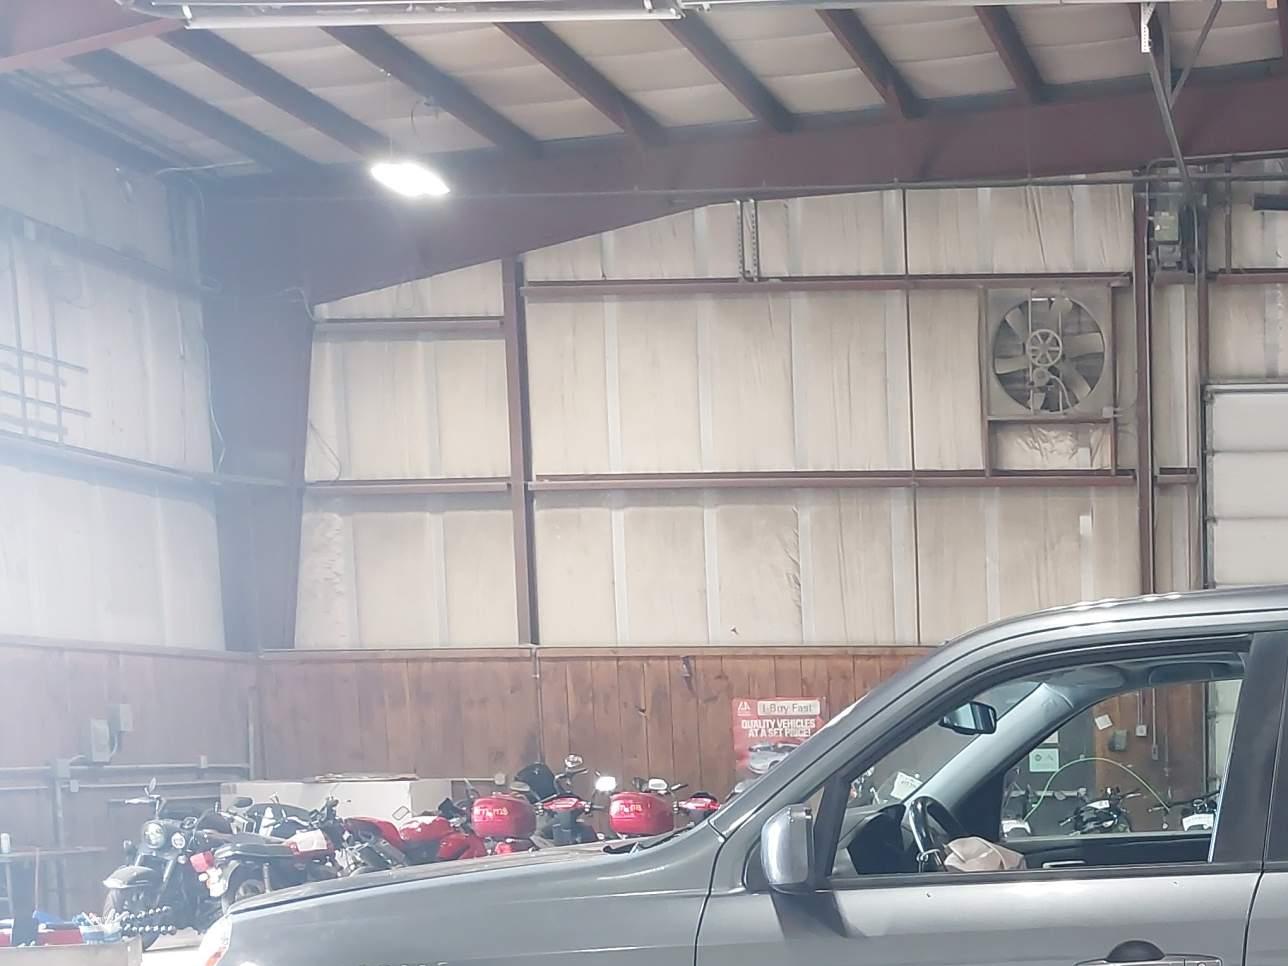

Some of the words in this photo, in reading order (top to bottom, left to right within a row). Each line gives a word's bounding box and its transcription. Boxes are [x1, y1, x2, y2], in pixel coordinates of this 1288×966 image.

[792, 703, 813, 713] Fast
[741, 718, 776, 729] QUALITY
[776, 718, 816, 729] VEHICLES
[748, 728, 759, 738] AT
[760, 728, 768, 738] A
[768, 728, 783, 738] SET
